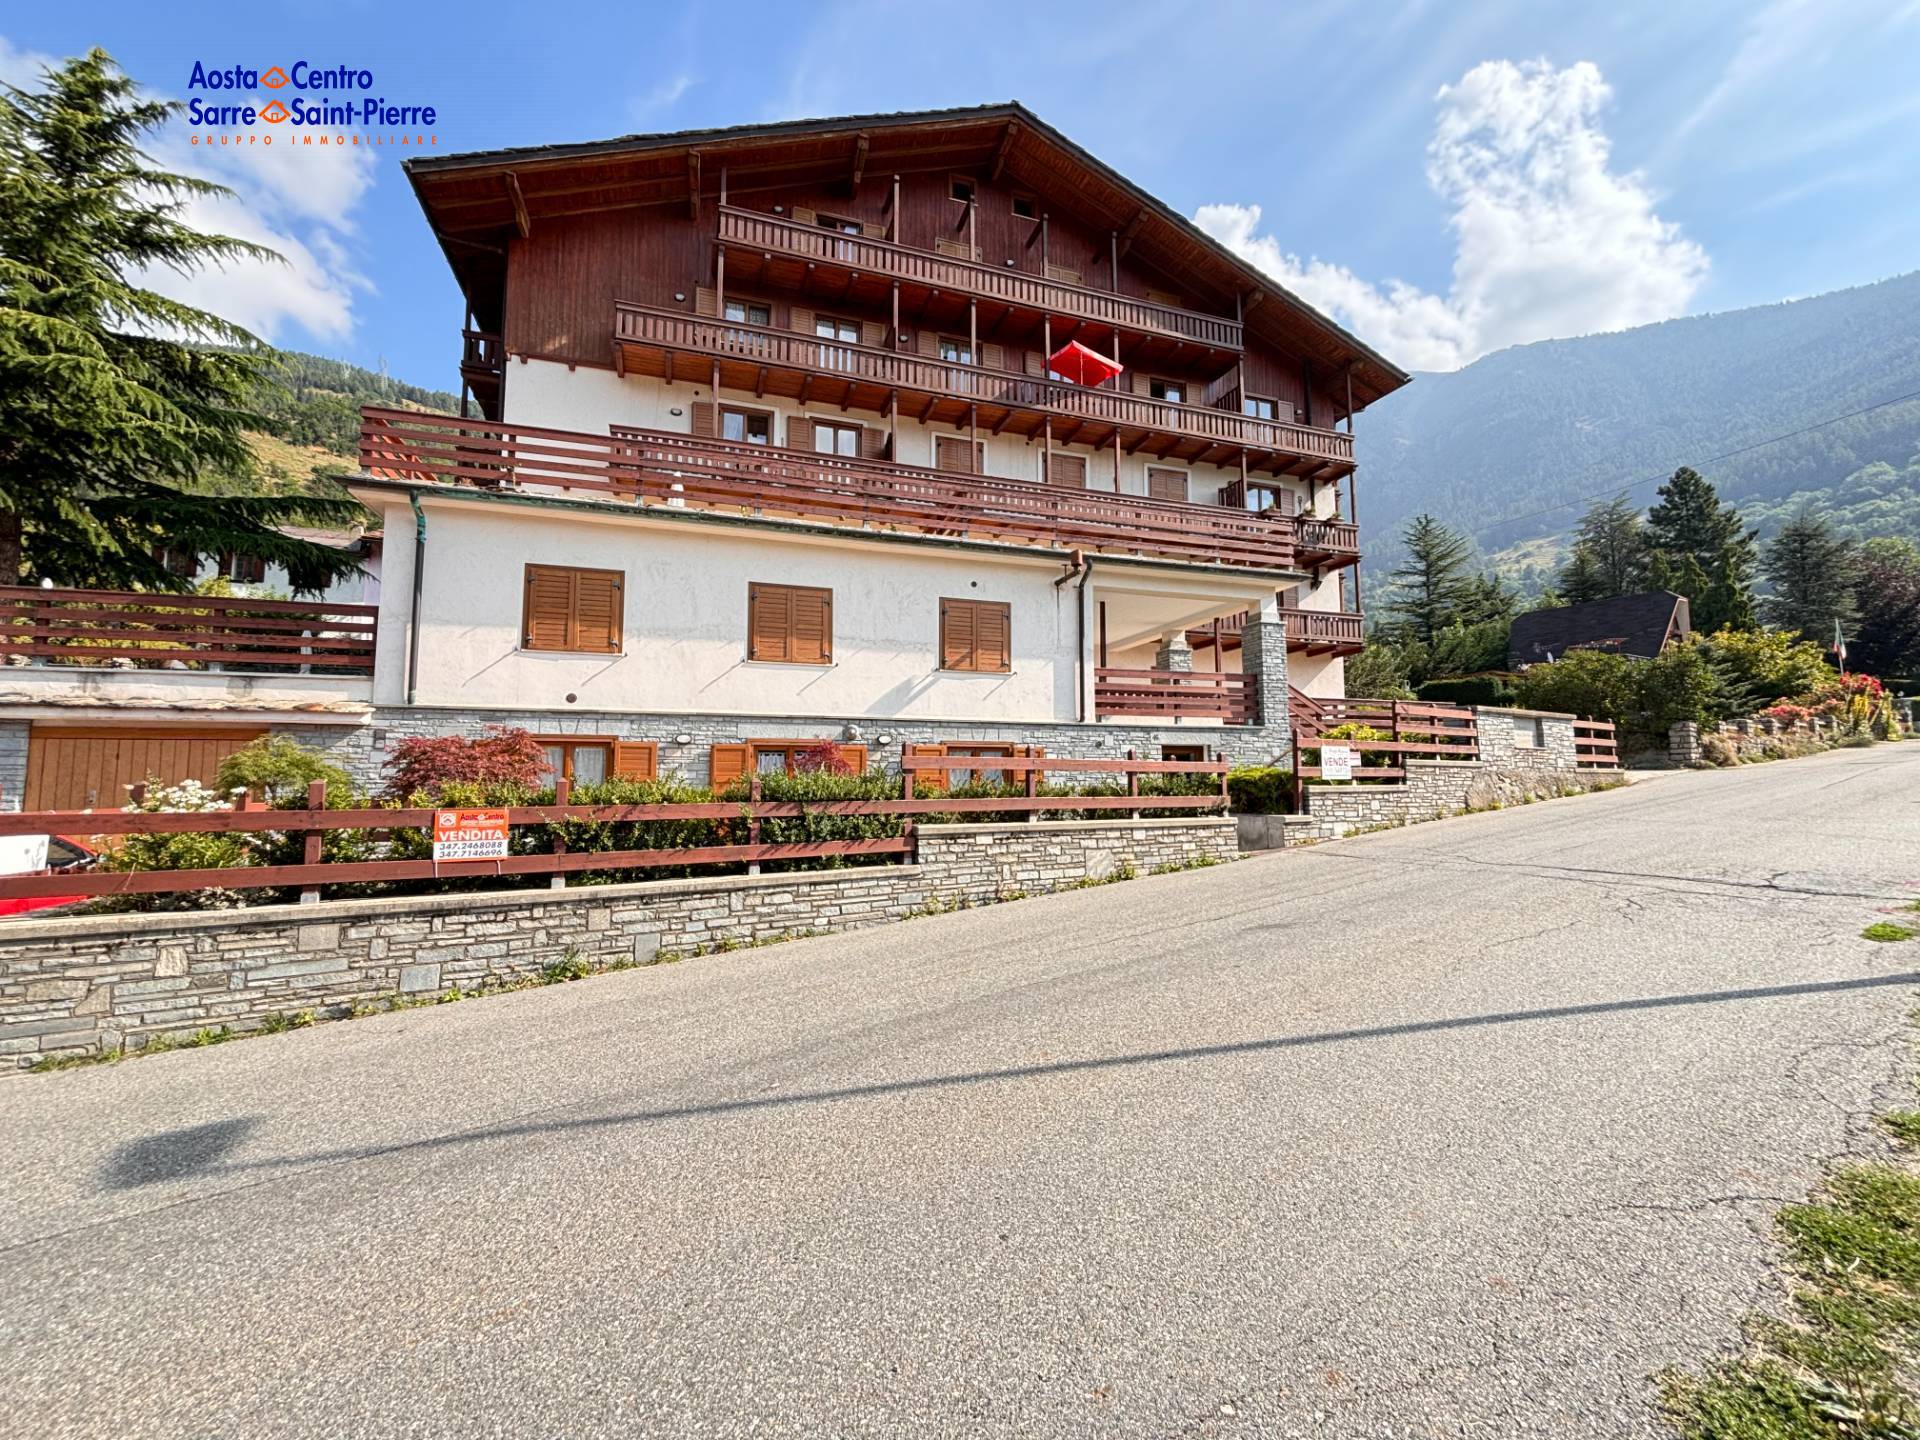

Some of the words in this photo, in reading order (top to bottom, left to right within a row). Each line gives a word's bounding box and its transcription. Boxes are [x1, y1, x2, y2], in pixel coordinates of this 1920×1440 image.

[1324, 757, 1349, 767] VENDE
[439, 830, 503, 842] VENDITA
[439, 842, 502, 851] 347.2468088
[439, 849, 502, 858] 347.7146696
